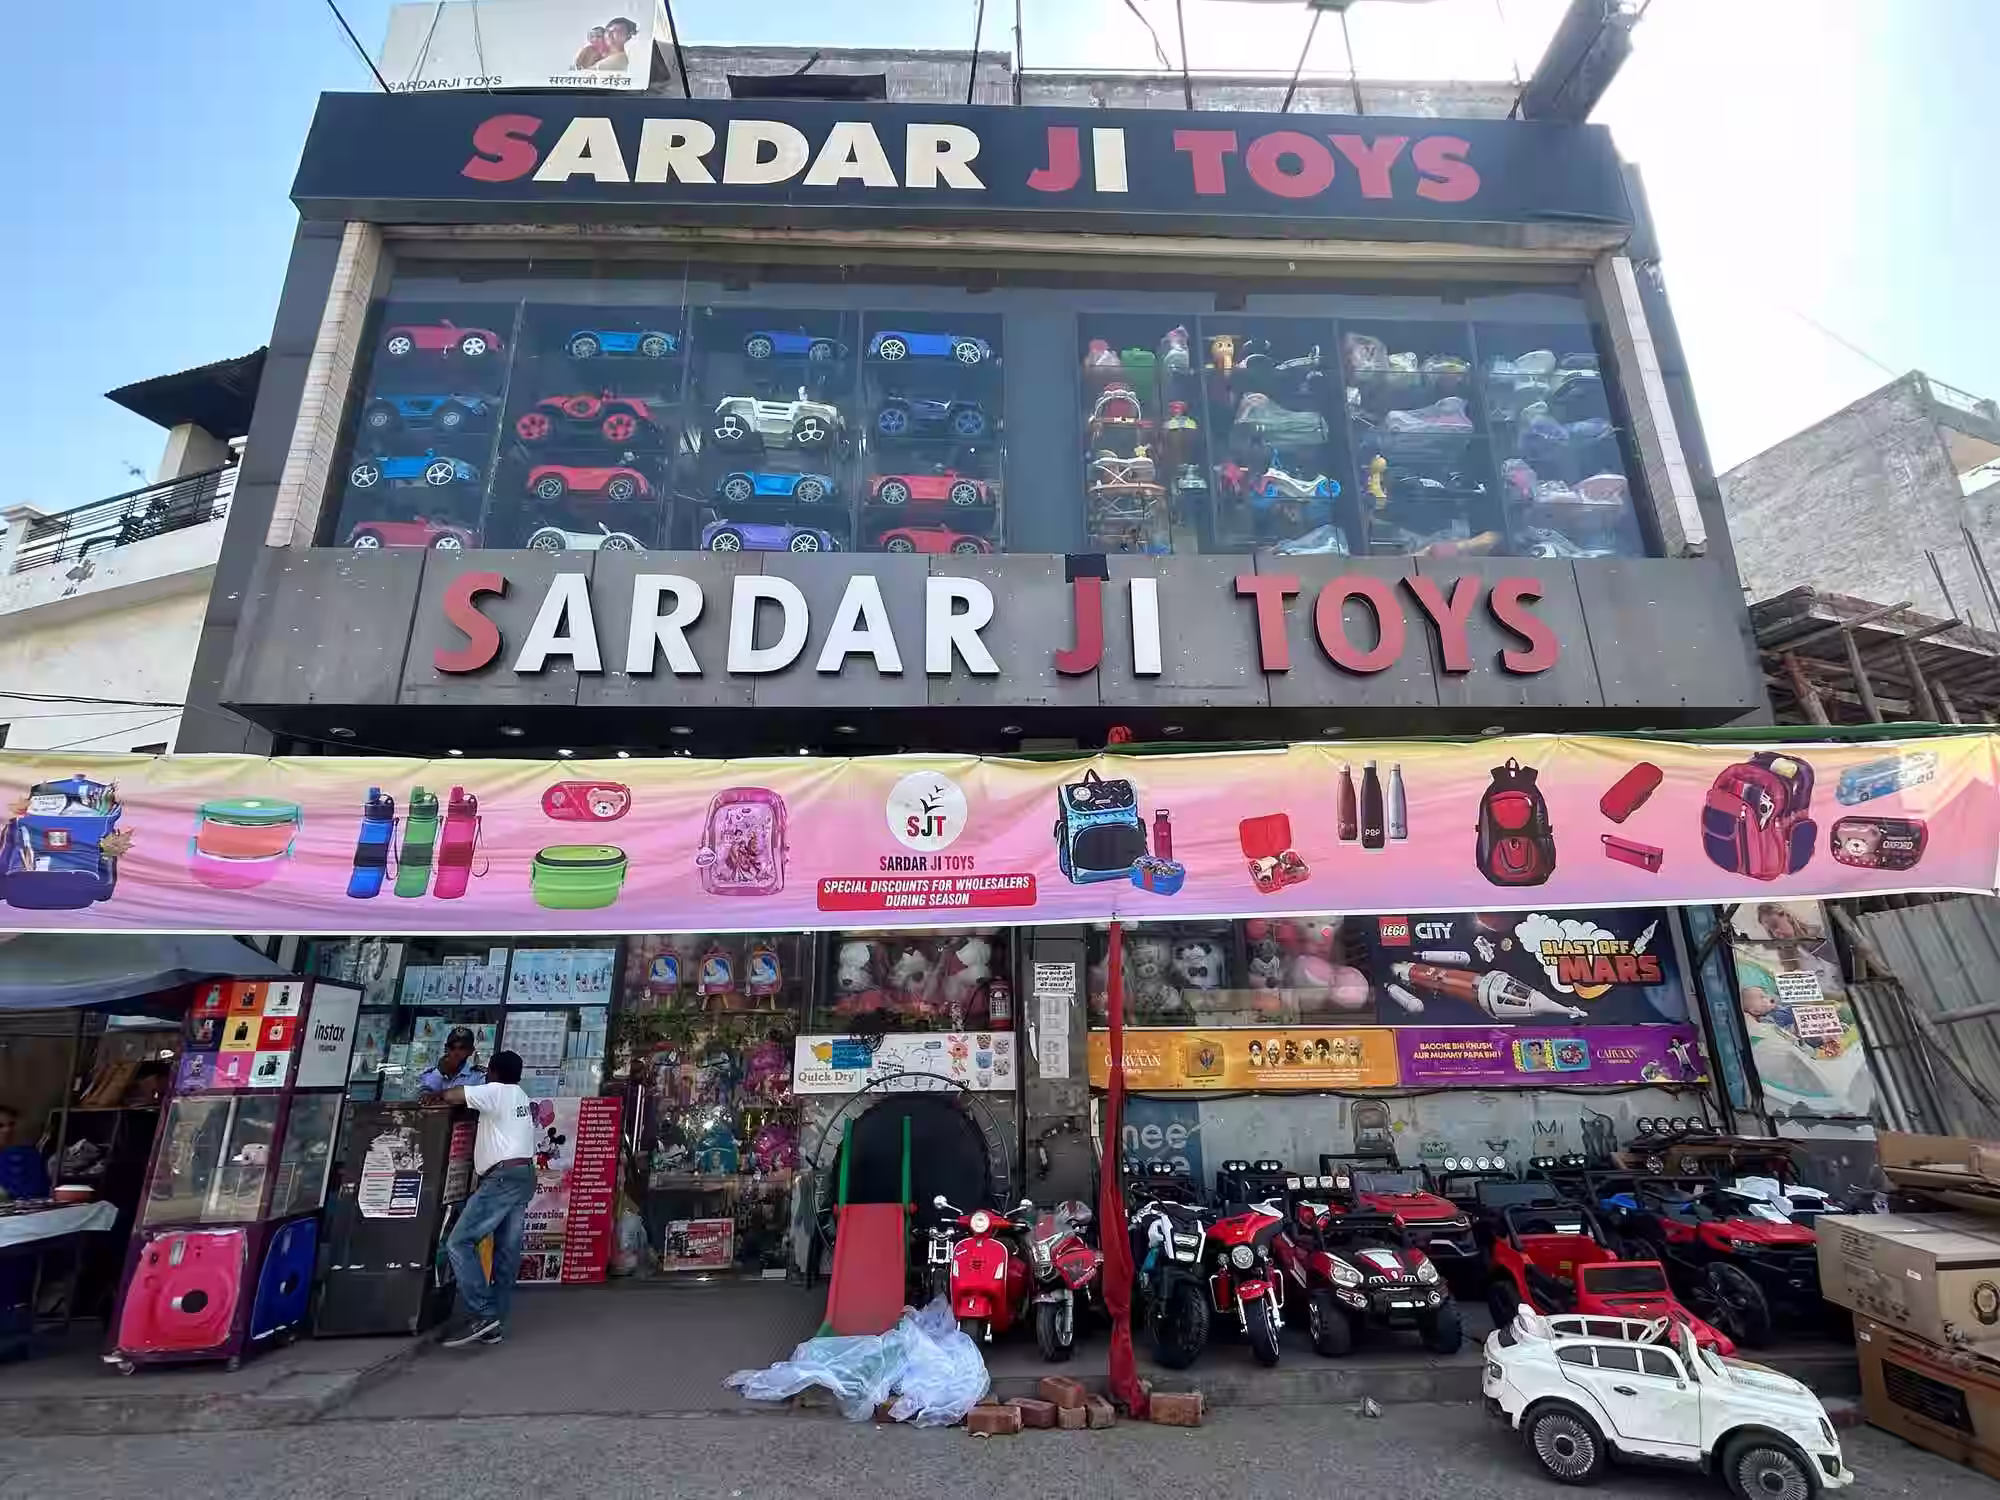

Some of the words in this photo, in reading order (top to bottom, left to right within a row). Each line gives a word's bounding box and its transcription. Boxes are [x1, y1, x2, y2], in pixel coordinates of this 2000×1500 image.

[465, 75, 503, 87] TOYS
[460, 113, 986, 189] SARDAR
[1026, 126, 1129, 193] JI
[1173, 129, 1481, 202] TOYS
[433, 571, 1001, 676] SARDAR
[1055, 577, 1162, 678] JI
[1234, 574, 1560, 676] TOYS
[906, 815, 947, 837] SJT
[879, 856, 927, 871] SARDAR
[930, 856, 942, 870] JI
[944, 856, 975, 870] TOYS
[824, 880, 868, 893] SPECIAL
[870, 879, 929, 893] DISCOUNTS
[931, 879, 953, 891] FOR
[956, 876, 1030, 891] WHOLESALERS
[885, 894, 926, 907] DURING
[929, 893, 970, 905] SEASON
[1382, 924, 1406, 936] LEGO
[1415, 922, 1453, 939] CITY
[1541, 940, 1594, 954] BLAST
[1598, 940, 1629, 954] OFF
[1544, 956, 1558, 966] TO
[1558, 955, 1662, 983] MARS
[314, 1019, 345, 1041] instax
[799, 1071, 833, 1084] Quick
[835, 1071, 856, 1082] Dry
